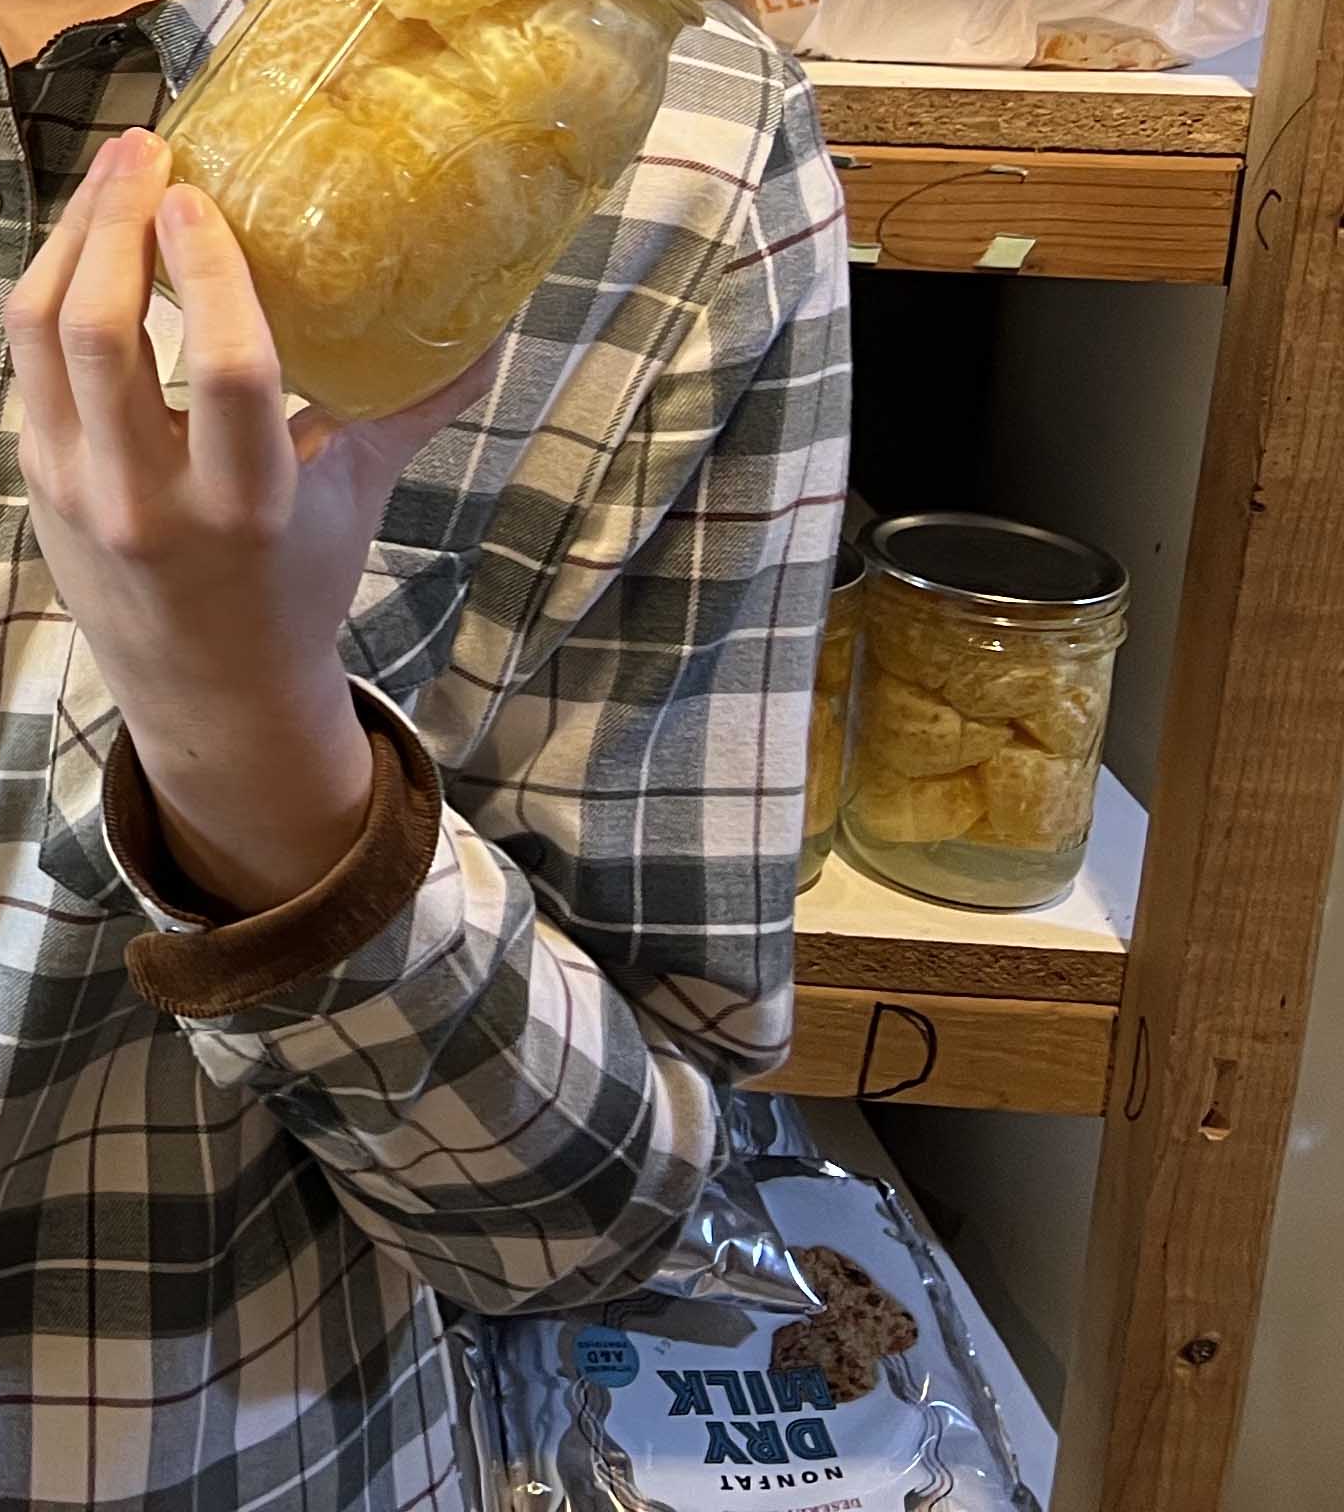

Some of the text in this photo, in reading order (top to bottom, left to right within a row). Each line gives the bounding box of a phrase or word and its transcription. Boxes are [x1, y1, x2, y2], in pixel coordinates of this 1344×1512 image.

[857, 1000, 939, 1102] D
[656, 1366, 838, 1418] MILK
[703, 1416, 839, 1467] DRY
[720, 1465, 845, 1492] NONFAT
